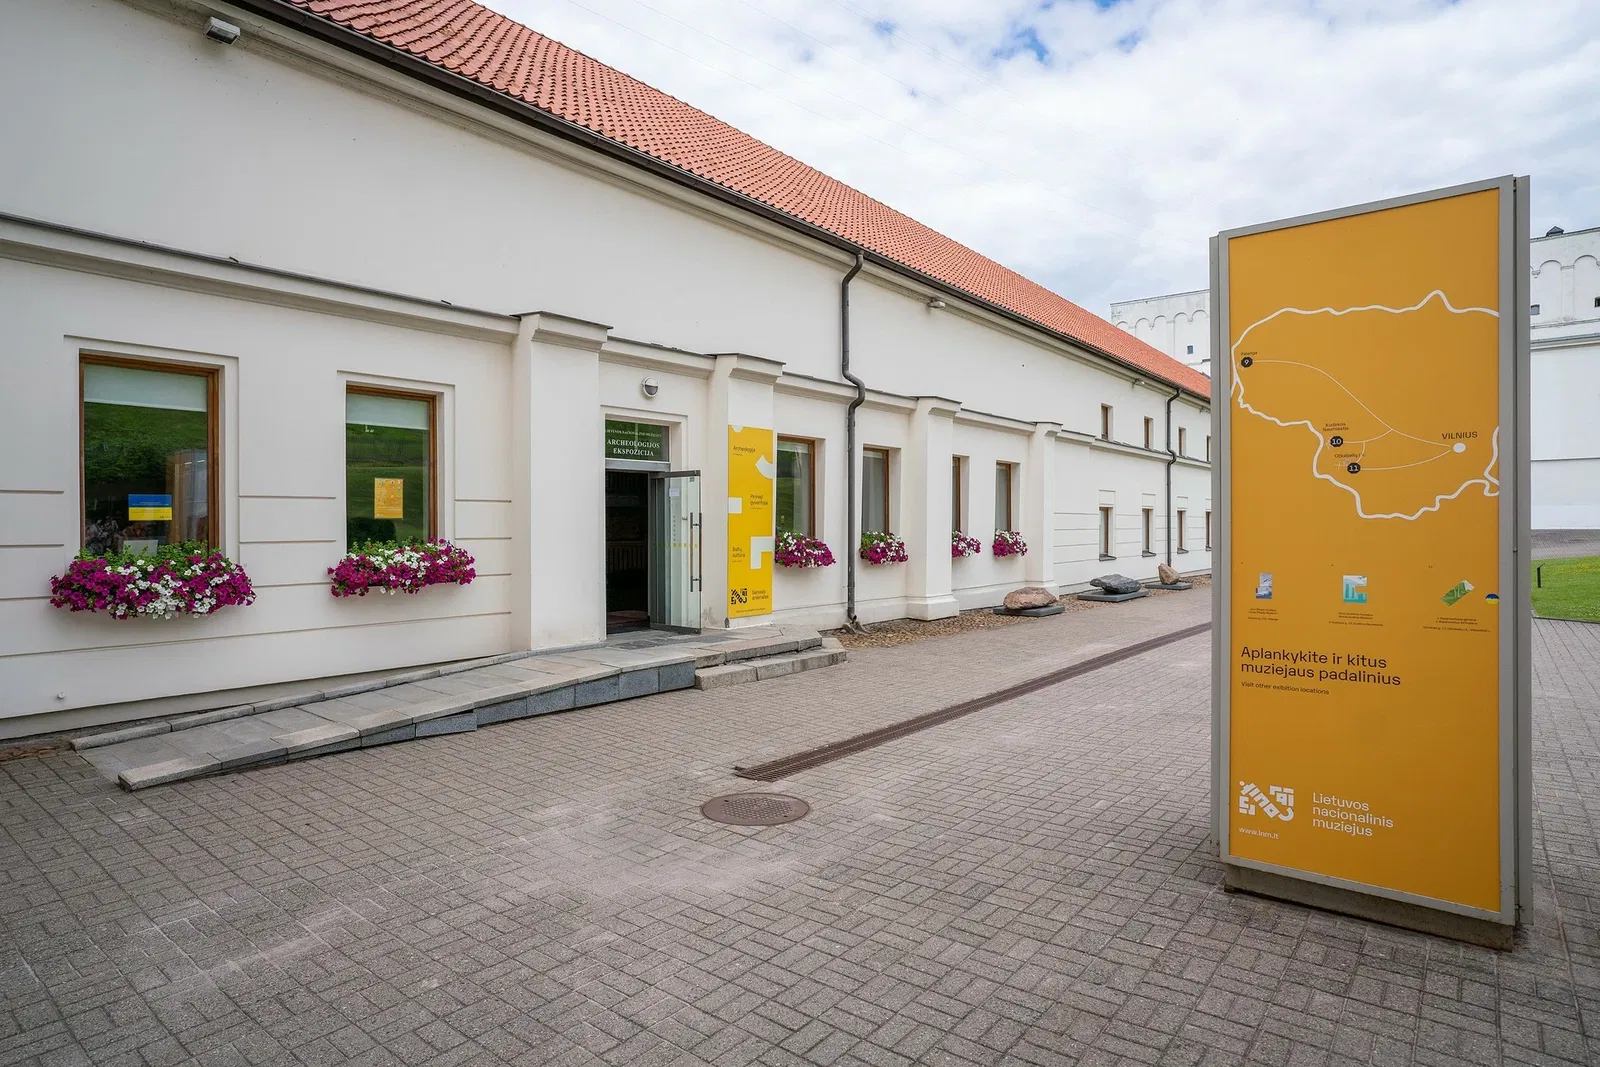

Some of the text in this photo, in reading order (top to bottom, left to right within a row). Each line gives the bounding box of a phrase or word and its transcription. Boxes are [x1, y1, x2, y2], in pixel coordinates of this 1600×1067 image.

[606, 438, 660, 448] ARCHEOLOGIJOS
[1441, 431, 1478, 439] VILNIUS
[613, 447, 654, 456] EKSPOZICIJA
[1241, 646, 1387, 668] Aplankykite ir kitus
[1241, 663, 1401, 686] muziejaus padalinius
[1255, 682, 1272, 690] other
[1272, 684, 1300, 692] exibition
[1300, 686, 1330, 695] locations
[1312, 792, 1370, 811] Lietuvos
[1312, 805, 1394, 828] nacionalinis
[1239, 826, 1279, 840] www.lnm.lt
[1312, 818, 1373, 837] muziejus
